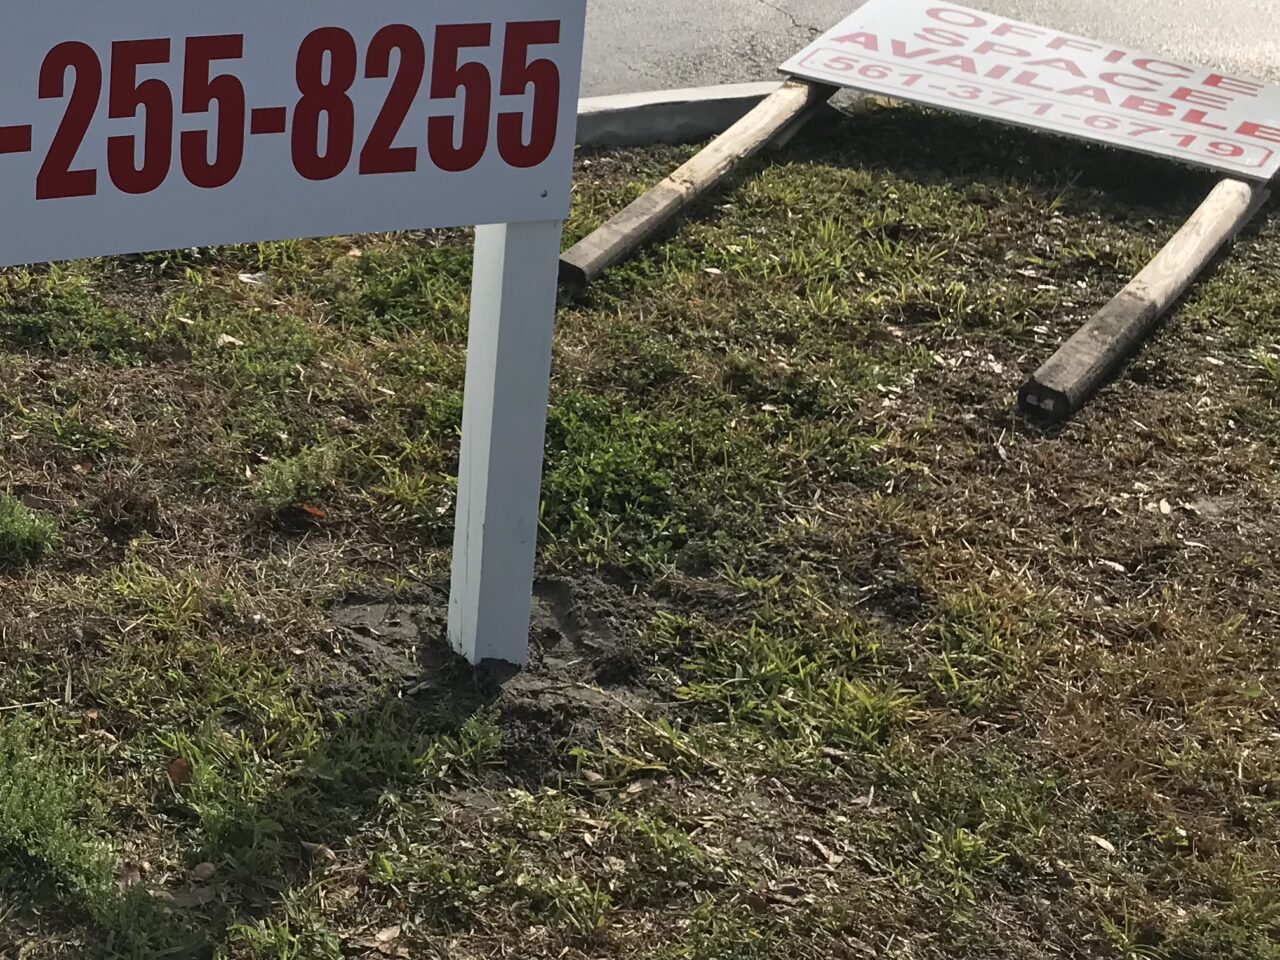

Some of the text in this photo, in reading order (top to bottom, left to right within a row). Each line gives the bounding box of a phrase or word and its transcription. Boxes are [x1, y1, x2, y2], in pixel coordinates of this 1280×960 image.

[830, 31, 1280, 143] AVAILABLE
[914, 27, 1234, 110] SPACE
[926, 8, 1264, 97] OFFICE
[823, 56, 1244, 157] 561-371-6719
